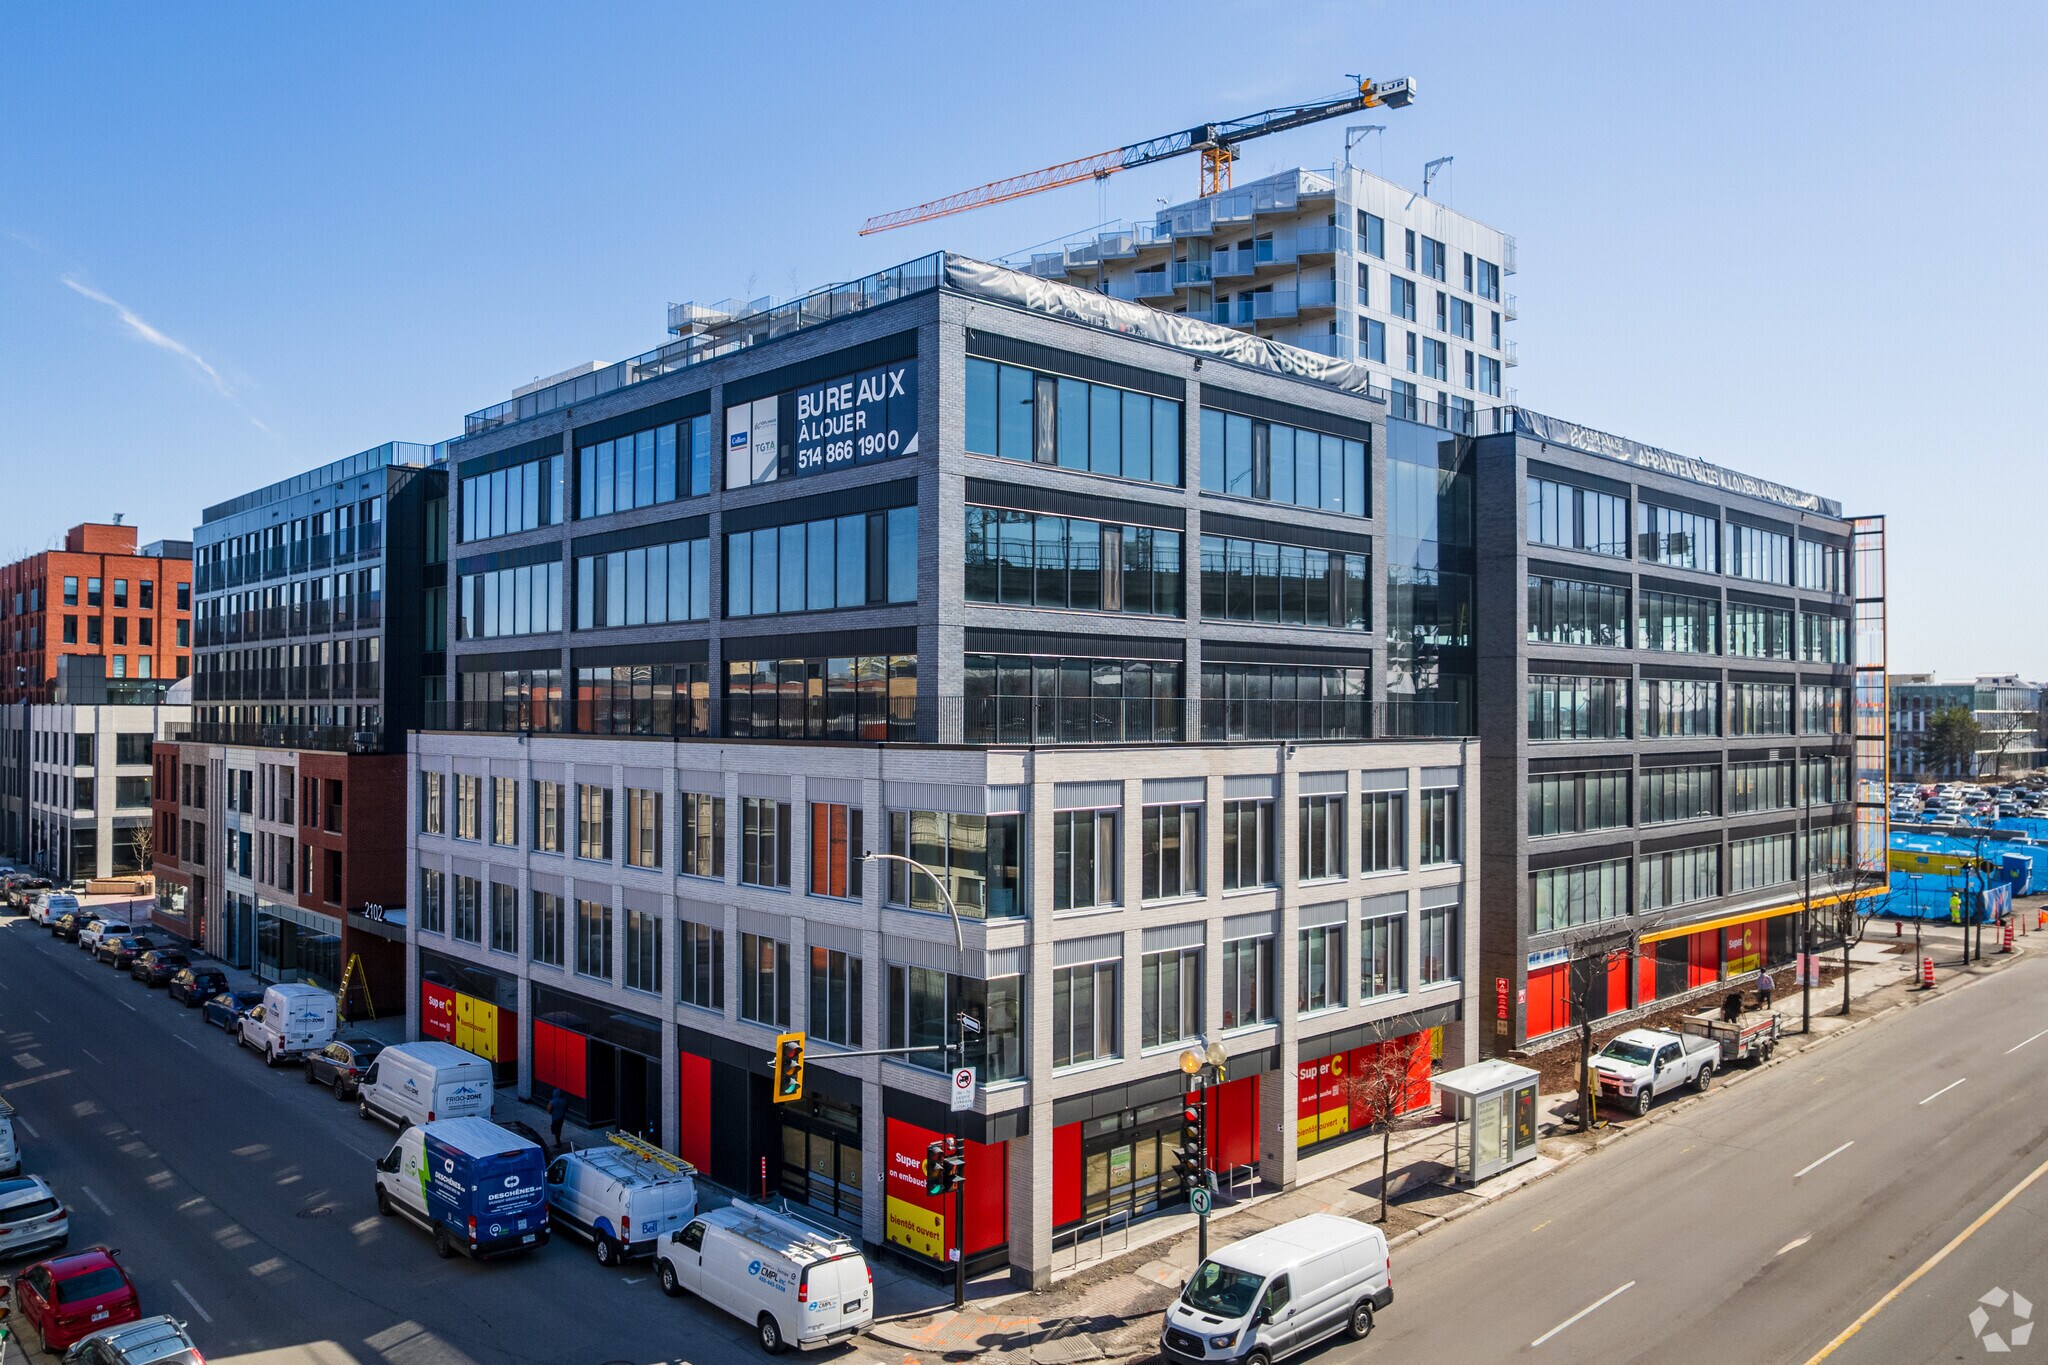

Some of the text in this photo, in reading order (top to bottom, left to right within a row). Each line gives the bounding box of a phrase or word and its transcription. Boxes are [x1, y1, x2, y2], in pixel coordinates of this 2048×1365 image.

[1381, 81, 1404, 92] LJP
[798, 368, 905, 420] BUREAUX
[798, 410, 866, 443] À LOUER
[755, 440, 775, 453] TGTA
[798, 429, 899, 469] 514 866 1900
[365, 901, 383, 922] 2102
[1744, 929, 1751, 950] C
[428, 995, 452, 1016] Super C
[1299, 1055, 1342, 1080] Super C
[446, 1093, 482, 1103] FRIGO-ZONE
[1319, 1119, 1338, 1130] ouvert
[895, 1152, 920, 1168] Super
[889, 1169, 898, 1178] on
[642, 1220, 658, 1235] Bell
[890, 1213, 940, 1241] bientôt ouvert
[760, 1267, 778, 1282] CMPL
